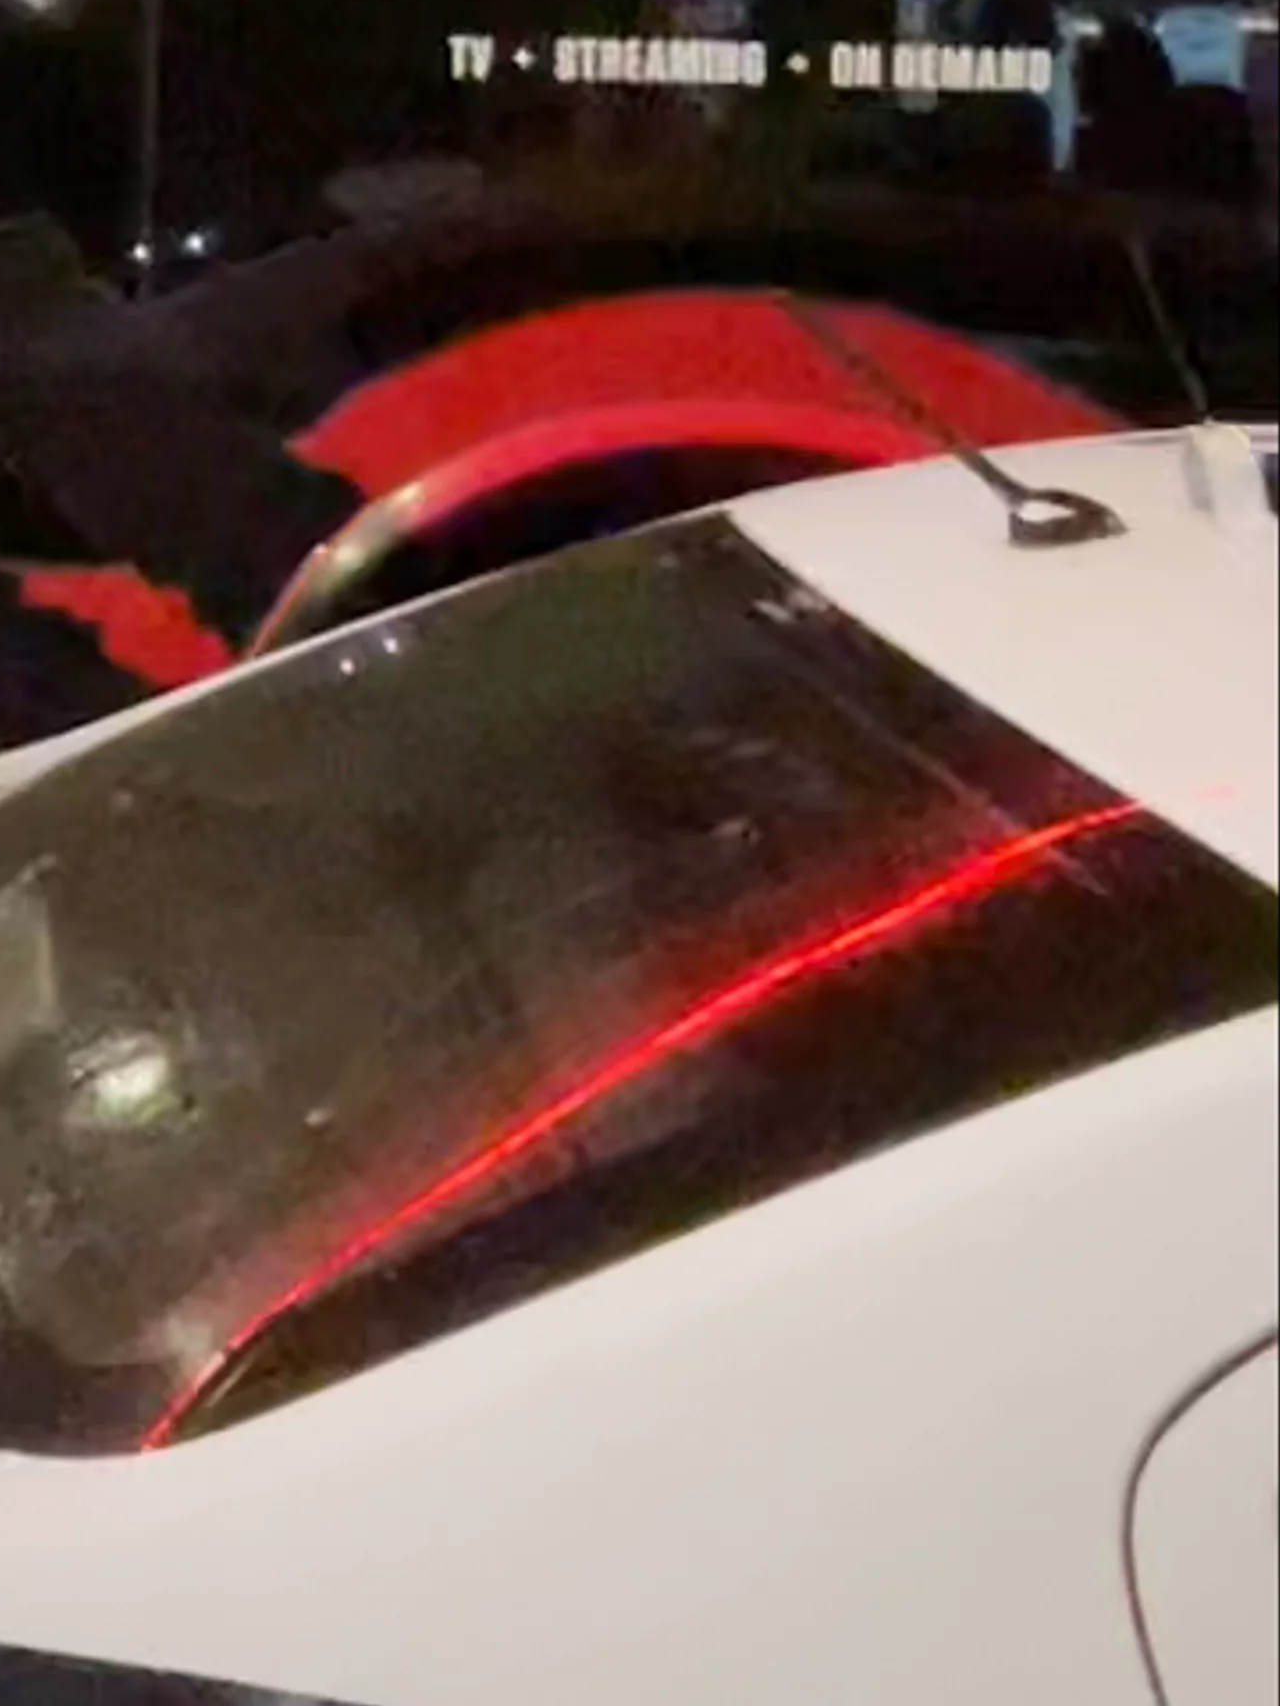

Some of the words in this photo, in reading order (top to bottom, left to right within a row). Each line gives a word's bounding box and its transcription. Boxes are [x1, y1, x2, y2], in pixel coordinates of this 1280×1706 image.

[447, 35, 495, 82] TV
[552, 35, 767, 86] STREAMING
[830, 42, 882, 89] ON
[893, 45, 1054, 93] DEMAND
